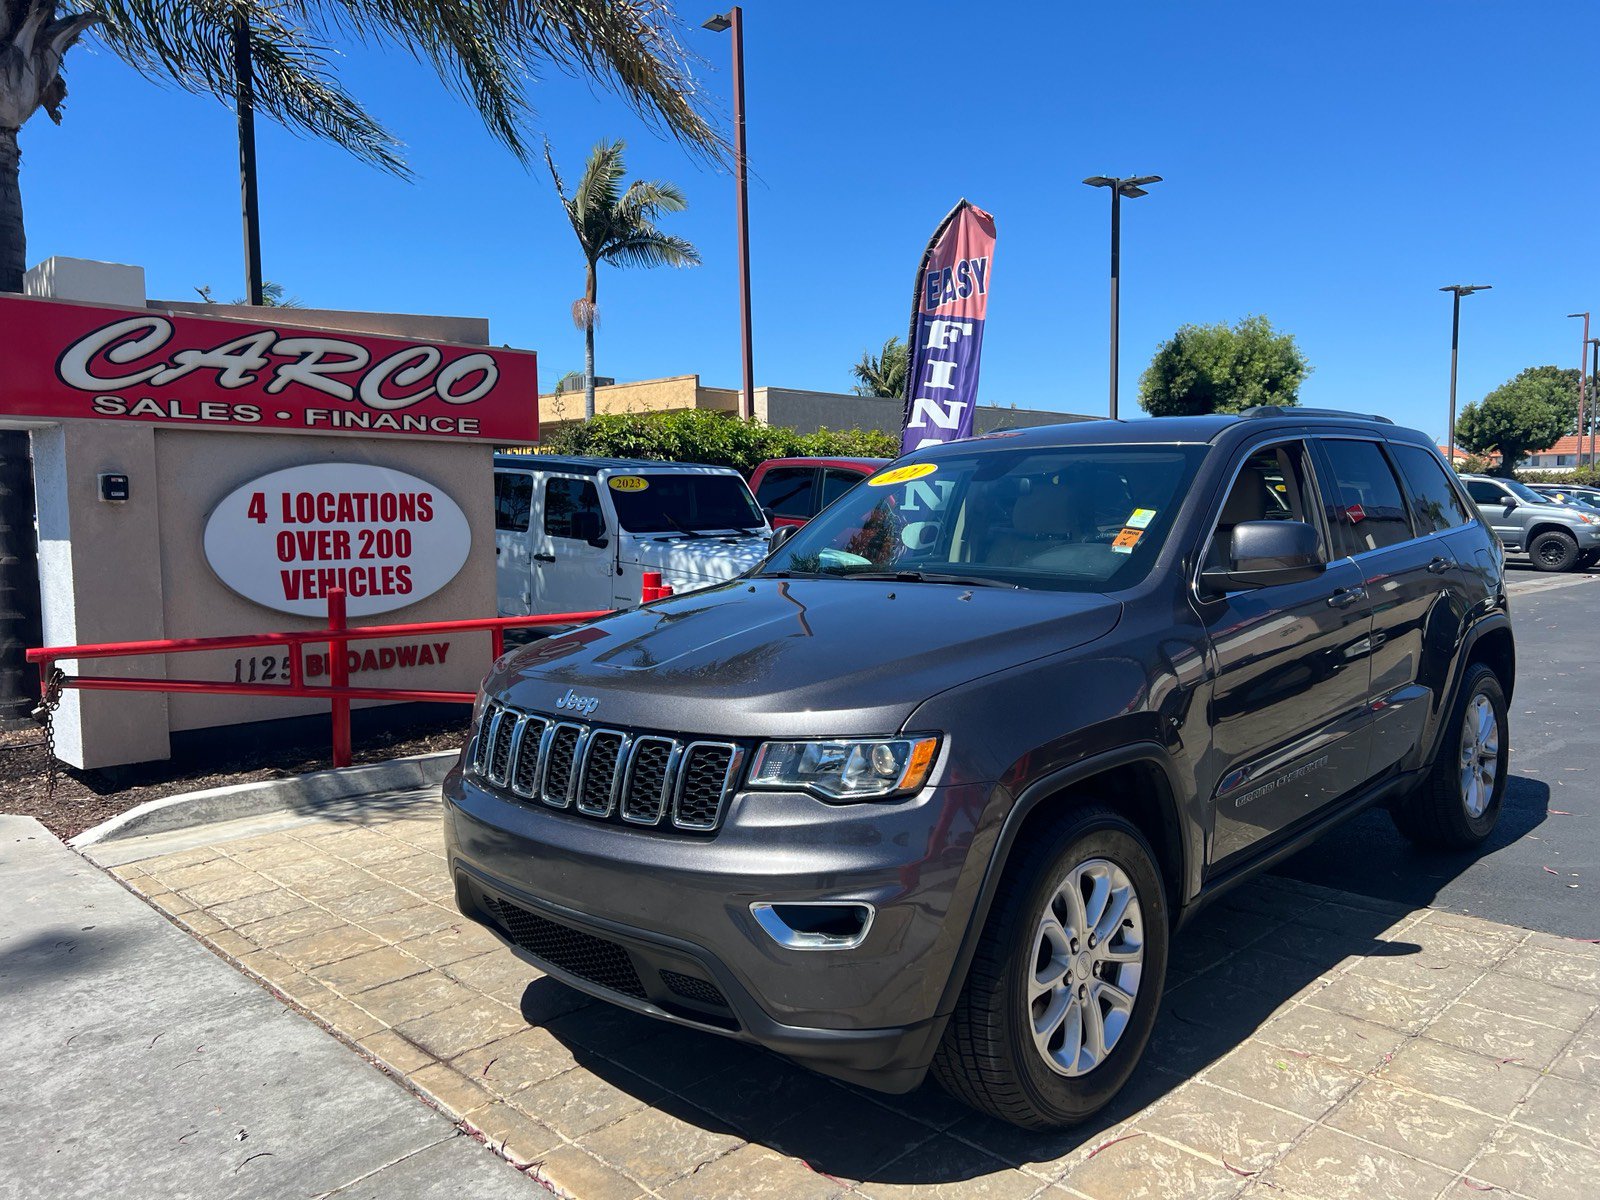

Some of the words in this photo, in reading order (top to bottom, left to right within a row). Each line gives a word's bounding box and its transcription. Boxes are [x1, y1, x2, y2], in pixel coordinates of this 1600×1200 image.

[926, 255, 989, 312] EASY
[55, 315, 500, 411] CARCO
[92, 395, 263, 422] SALES
[304, 408, 481, 434] FINANCE
[616, 479, 641, 488] 2023
[248, 492, 268, 524] 4
[282, 492, 434, 523] LOCATIONS
[276, 530, 351, 562] OVER
[358, 528, 412, 559] 200
[280, 565, 413, 600] VEHICLES
[234, 655, 291, 683] 1125
[556, 689, 599, 716] Jeep
